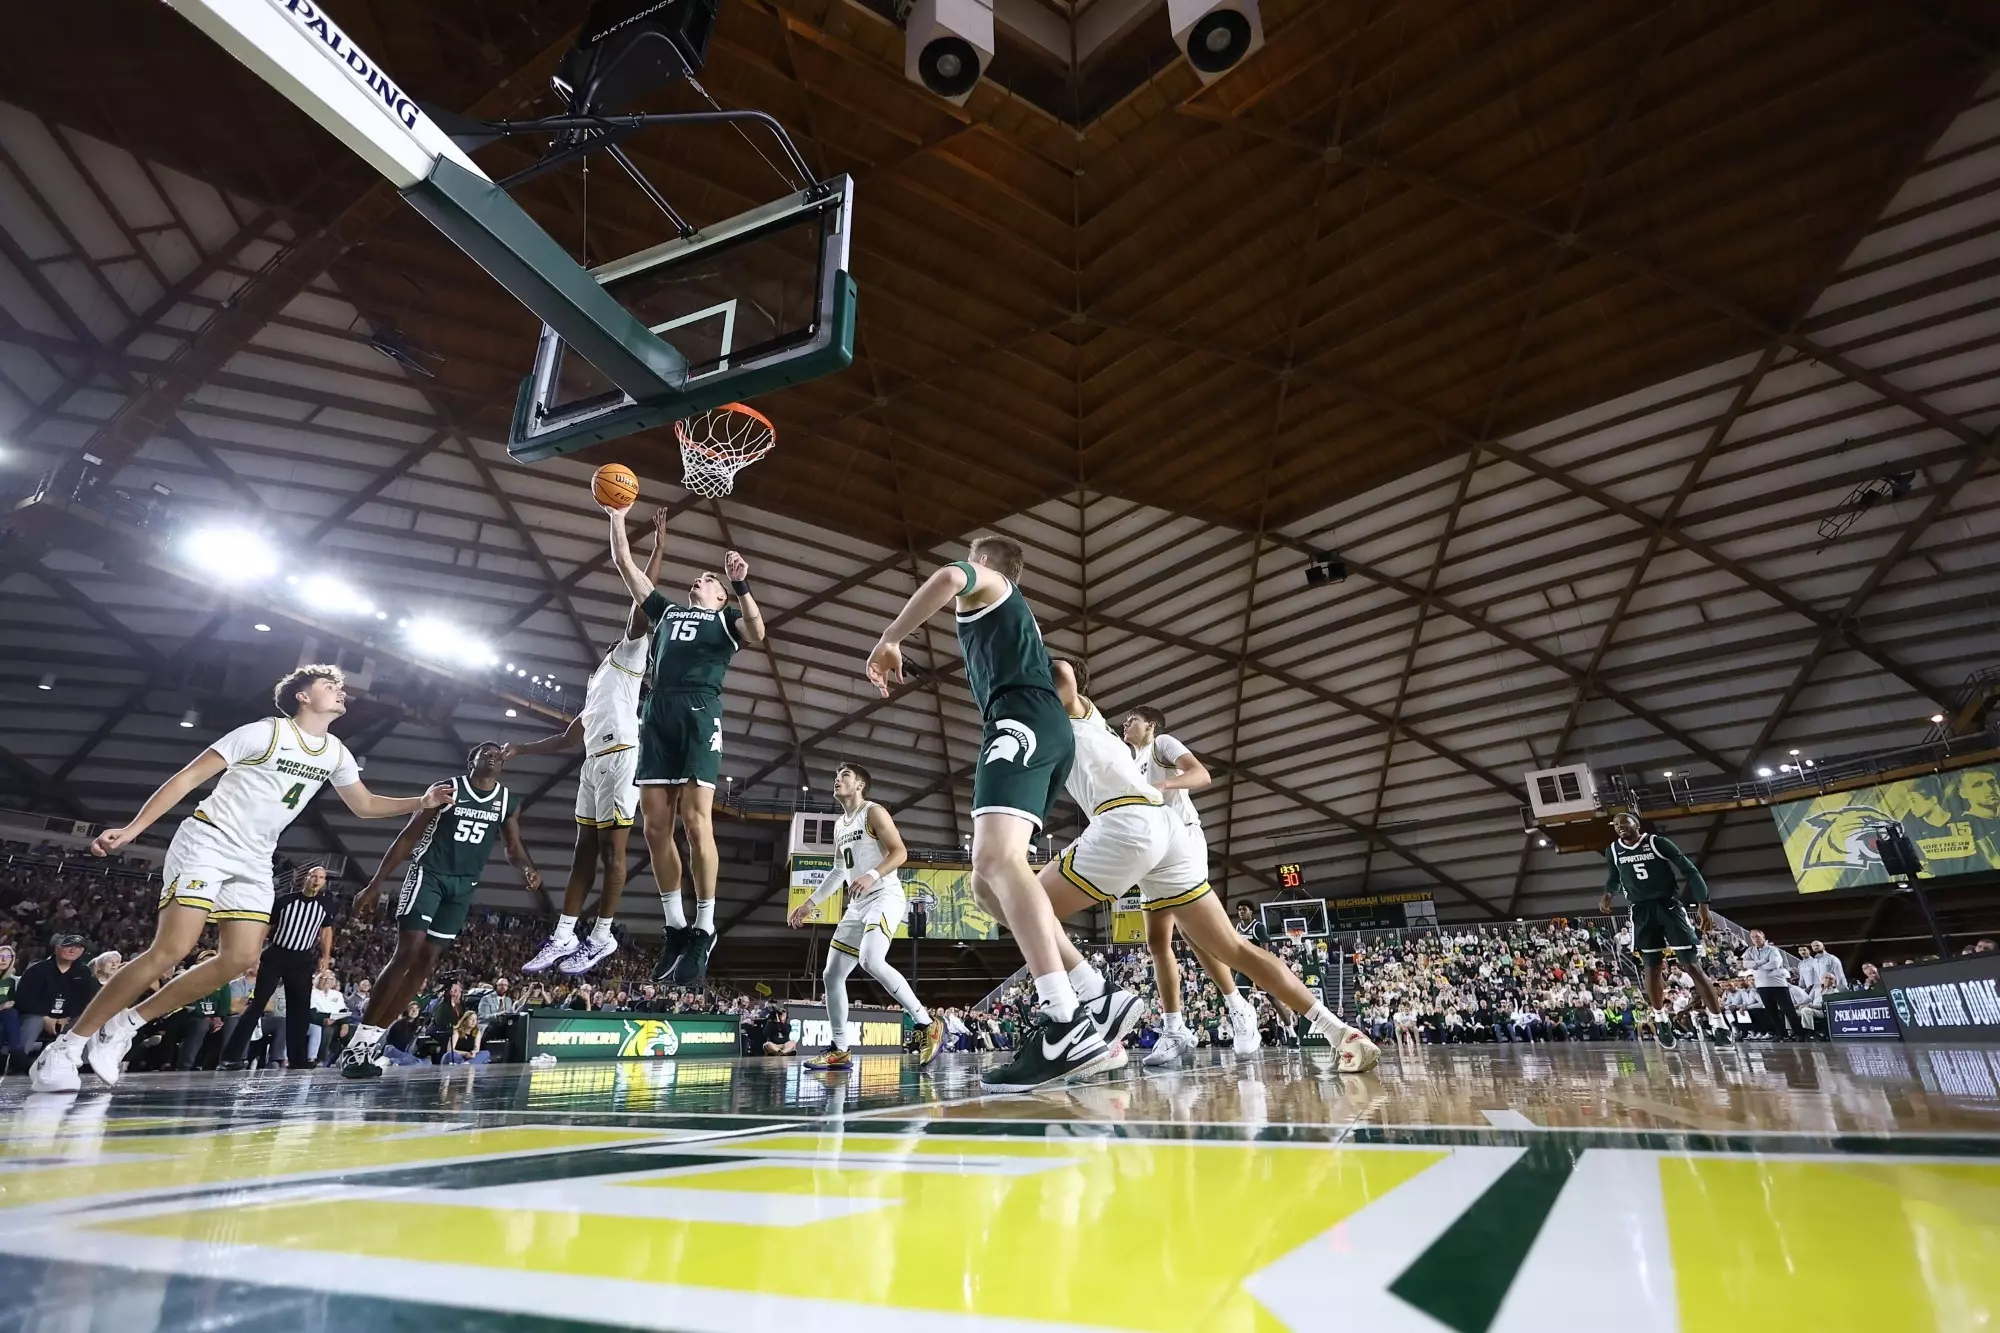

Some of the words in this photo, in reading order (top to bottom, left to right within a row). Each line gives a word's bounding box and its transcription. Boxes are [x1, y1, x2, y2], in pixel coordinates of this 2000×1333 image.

[278, 0, 419, 130] PALDING
[666, 611, 716, 621] SPARTANS
[670, 620, 700, 641] 15
[276, 758, 331, 776] NORTHERN
[277, 765, 326, 782] MICHIGAN
[281, 782, 306, 809] 4
[453, 807, 500, 822] SPARTANS
[453, 819, 490, 844] 55
[844, 847, 854, 868] 0
[1619, 853, 1655, 865] SPARTANS
[1280, 864, 1300, 874] 13:57
[1633, 863, 1649, 880] 5
[1283, 873, 1299, 887] 30
[1336, 896, 1378, 908] MICHIGAN
[1380, 891, 1432, 904] UNIVERSITY
[1905, 983, 1970, 1027] SUPERIOR
[536, 1032, 620, 1045] NORTHERN
[681, 1032, 736, 1044] MICHIGAN
